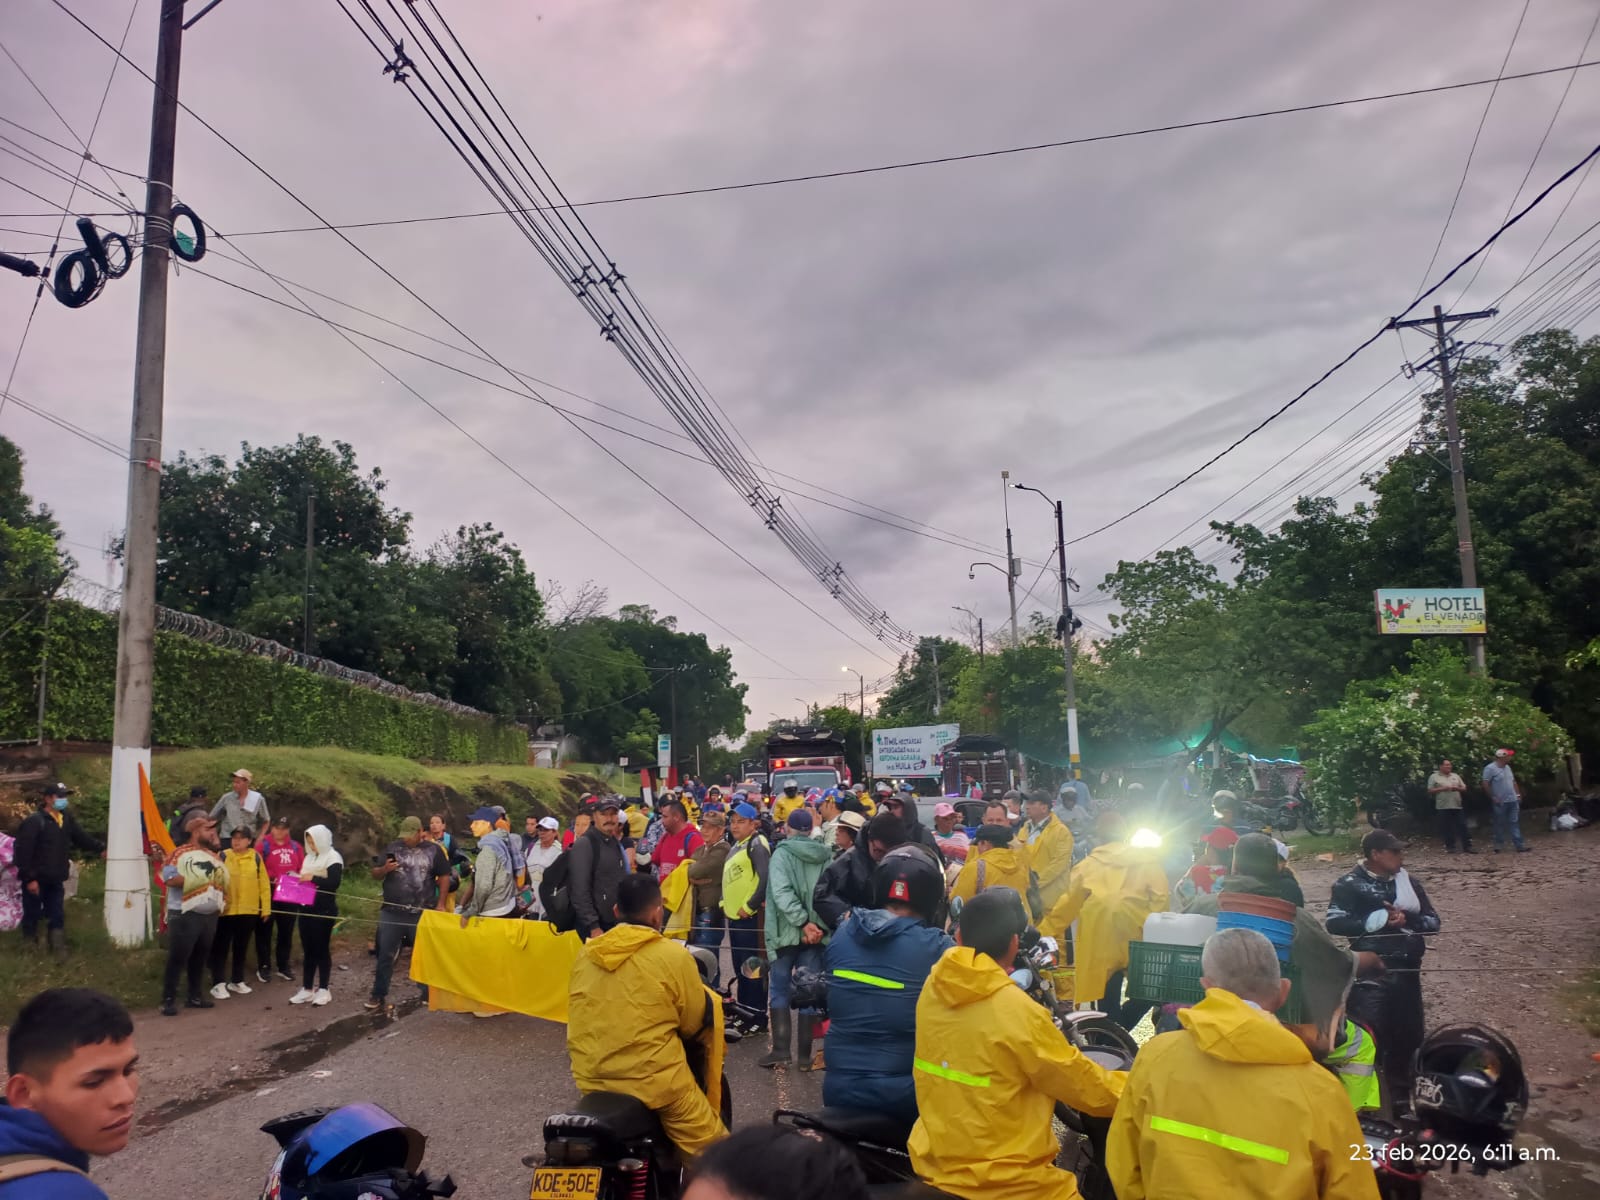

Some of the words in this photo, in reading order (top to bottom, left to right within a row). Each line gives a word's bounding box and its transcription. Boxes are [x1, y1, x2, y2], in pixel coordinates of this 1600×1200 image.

[1424, 596, 1483, 611] HOTEL
[1424, 612, 1437, 621] EL
[1439, 612, 1486, 621] VENADO
